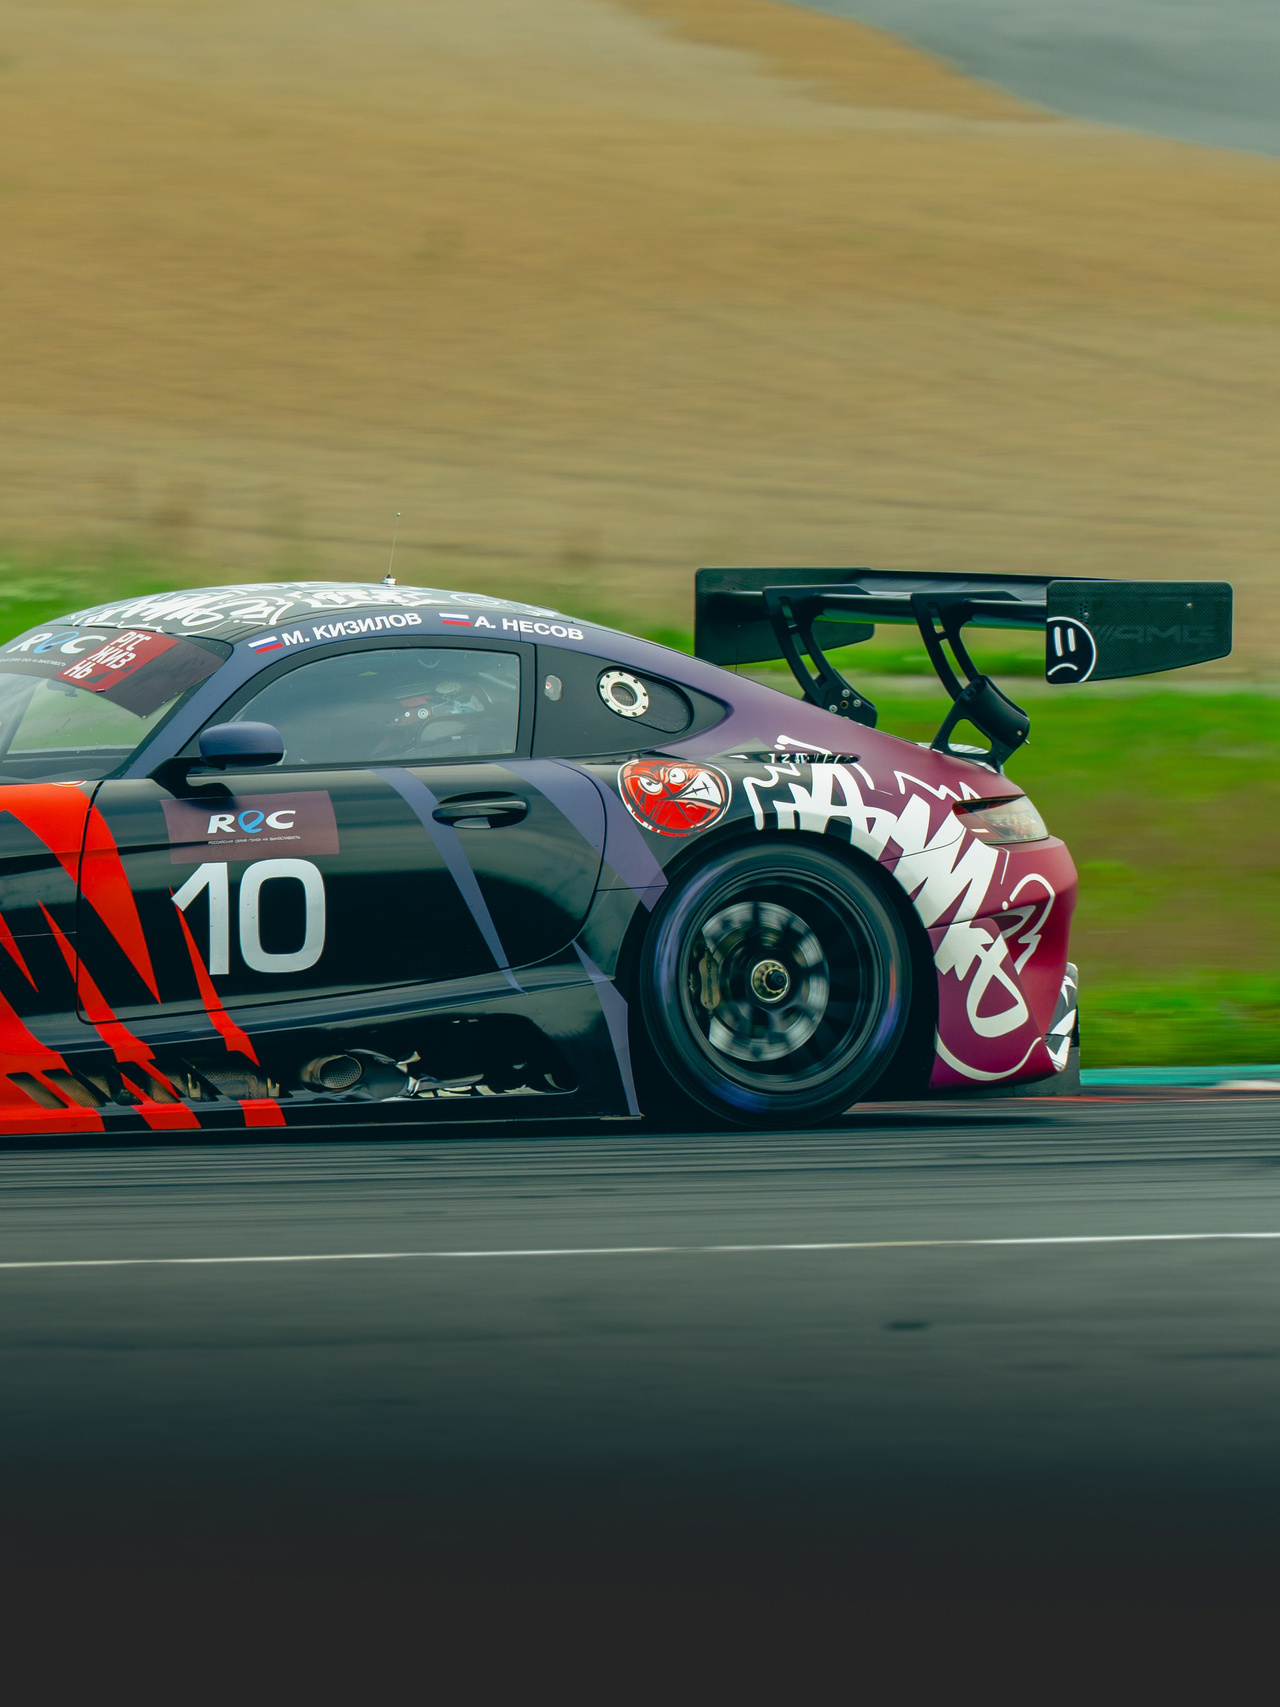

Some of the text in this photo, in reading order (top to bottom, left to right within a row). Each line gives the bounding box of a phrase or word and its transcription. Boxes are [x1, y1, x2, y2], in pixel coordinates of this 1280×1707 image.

[281, 612, 422, 646] М. КИЗИЛОВ
[474, 616, 584, 641] А. НЕСОВ
[88, 645, 137, 669] ЖИЗ
[63, 660, 98, 680] НЬ
[171, 858, 326, 975] 10
